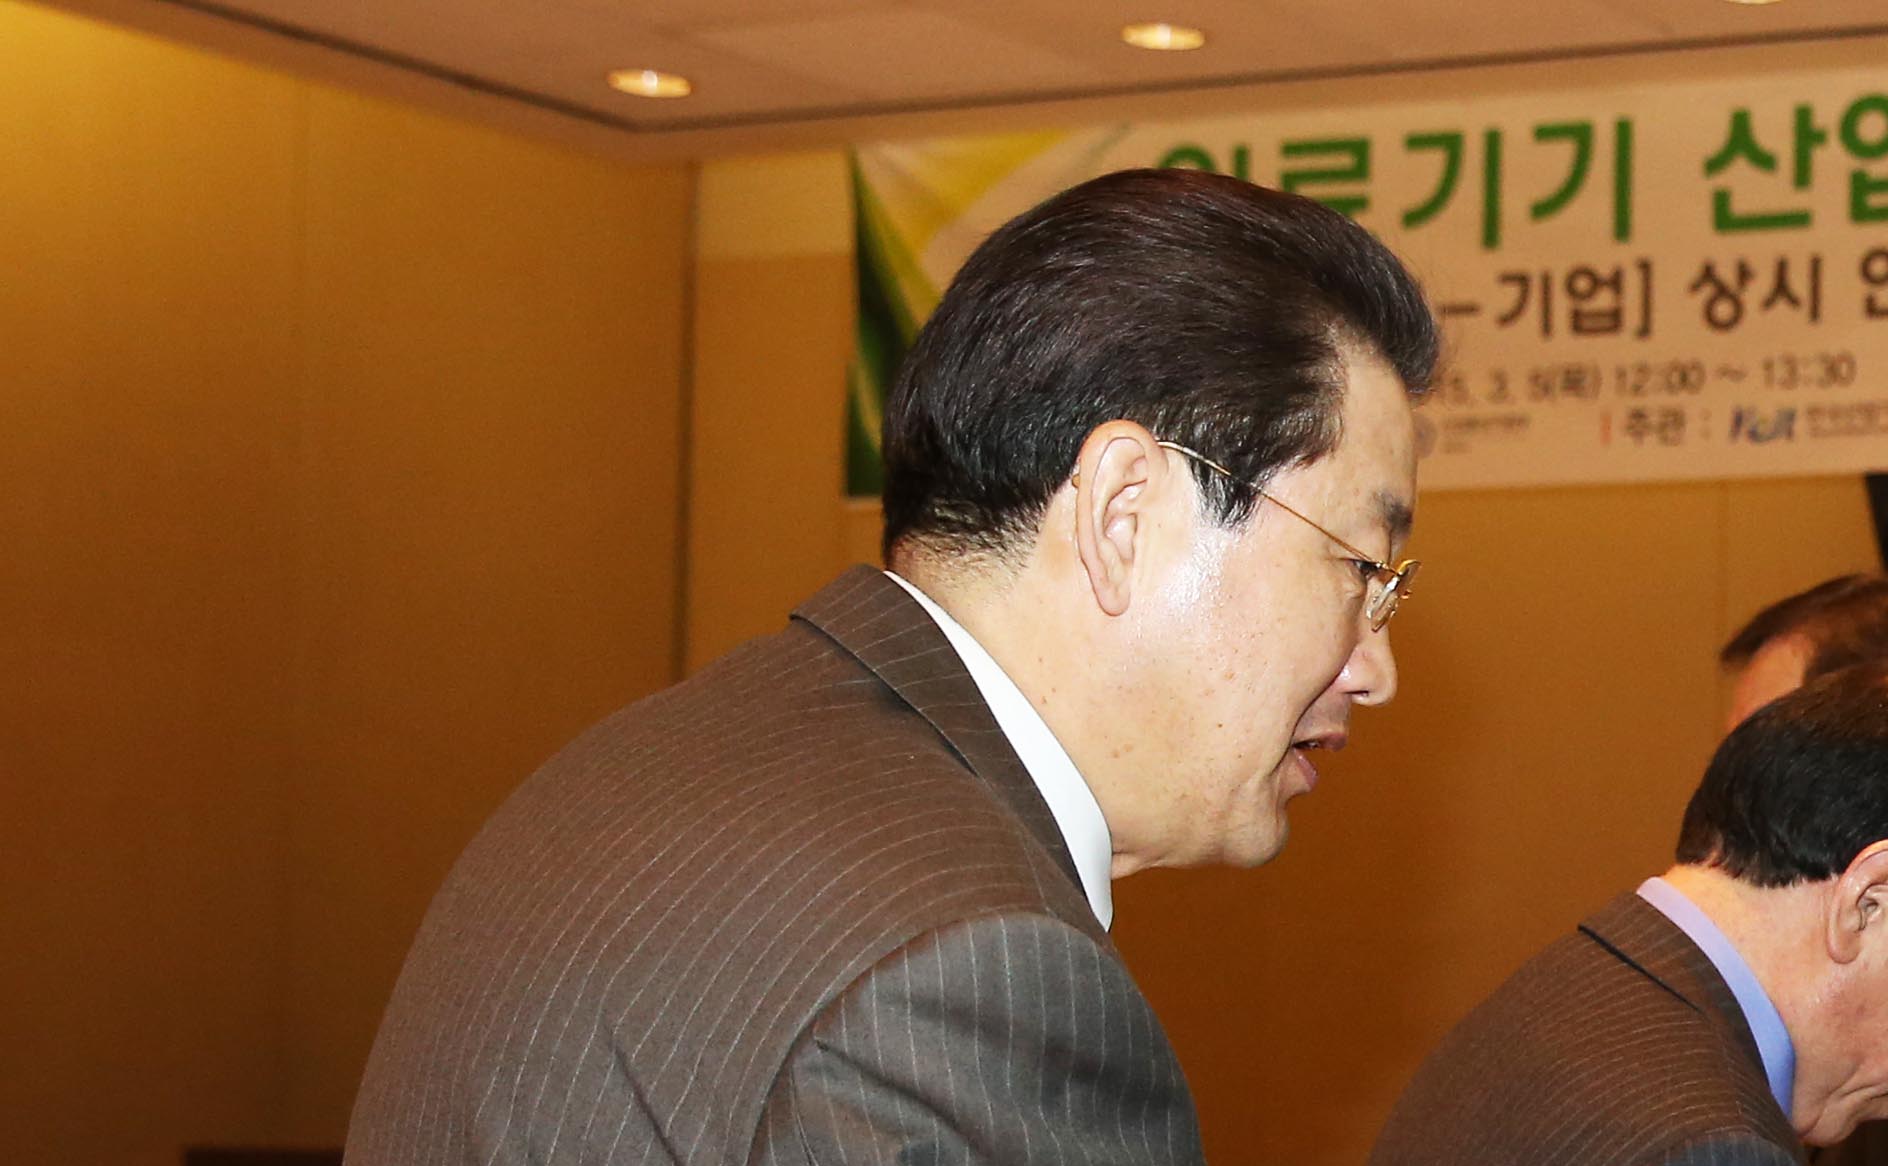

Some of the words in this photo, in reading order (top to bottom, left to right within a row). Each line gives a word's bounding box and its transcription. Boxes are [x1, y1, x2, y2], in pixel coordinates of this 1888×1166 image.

[1688, 254, 1824, 333] 상시
[1614, 360, 1706, 398] 12:00
[1762, 351, 1857, 391] 13:30
